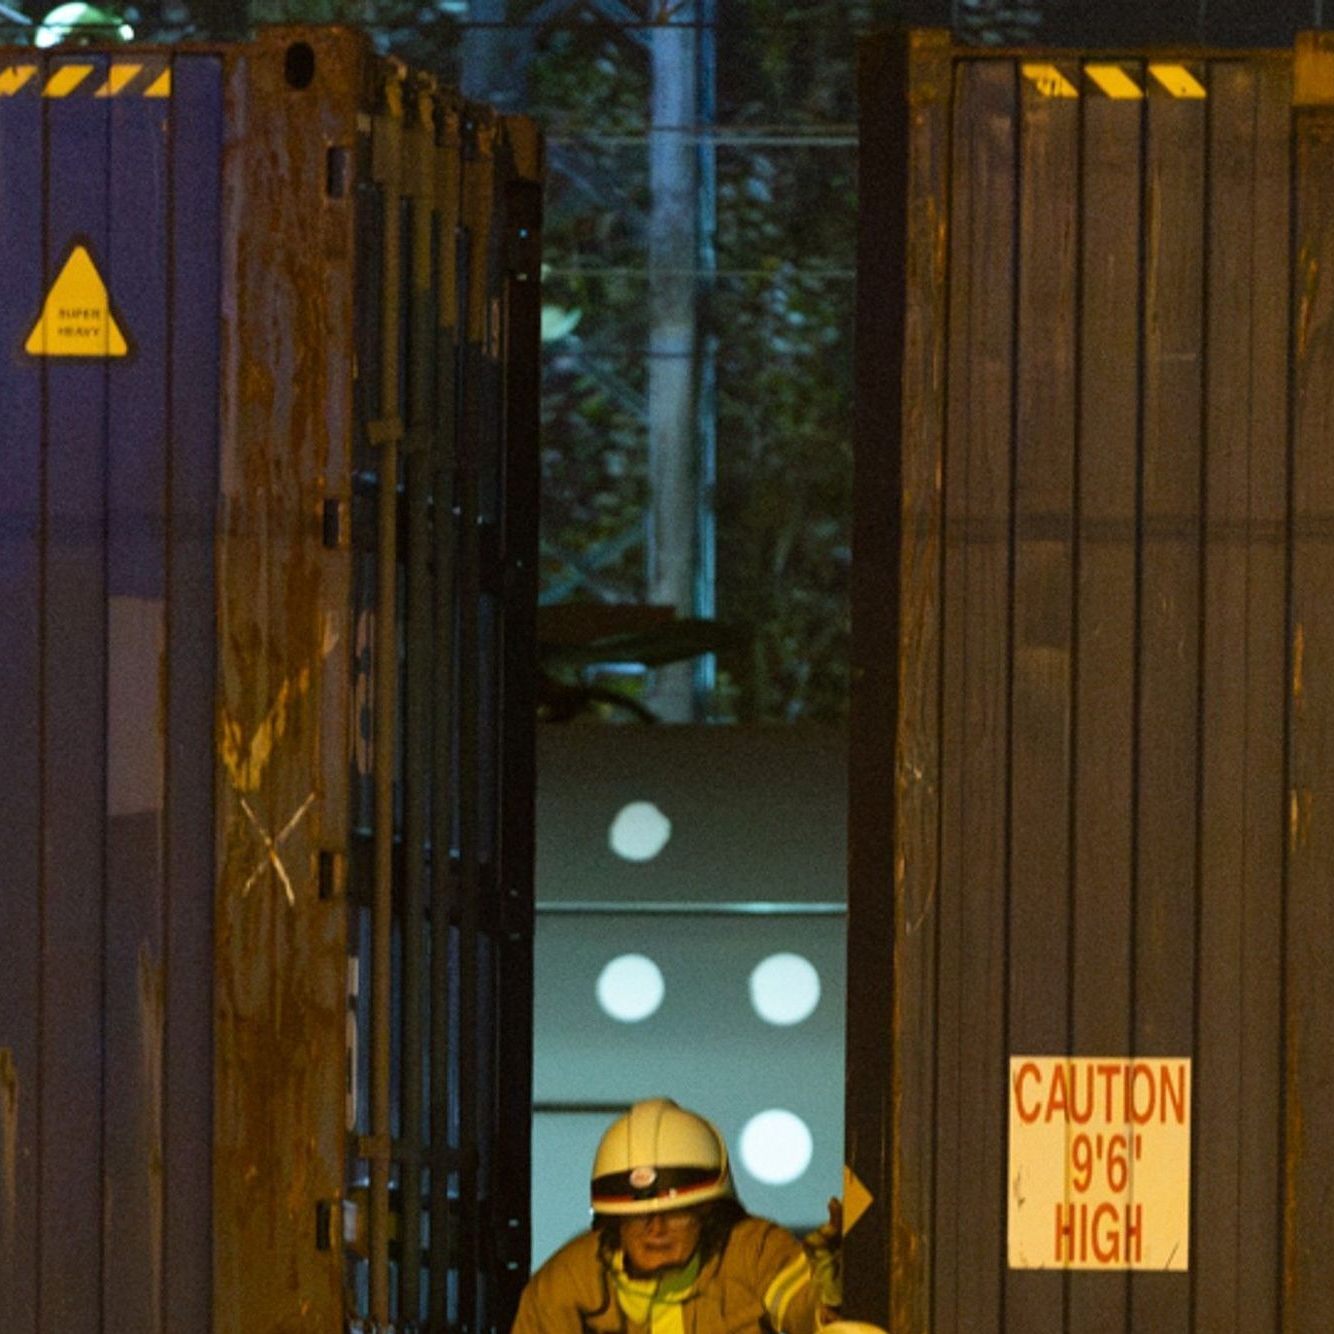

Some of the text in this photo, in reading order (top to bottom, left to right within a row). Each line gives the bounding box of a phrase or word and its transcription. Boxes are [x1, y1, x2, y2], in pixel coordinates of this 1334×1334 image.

[58, 308, 100, 319] SUPER
[58, 326, 100, 337] HEAVY
[1015, 1062, 1186, 1124] CAUTION
[1055, 1202, 1143, 1263] HIGH
